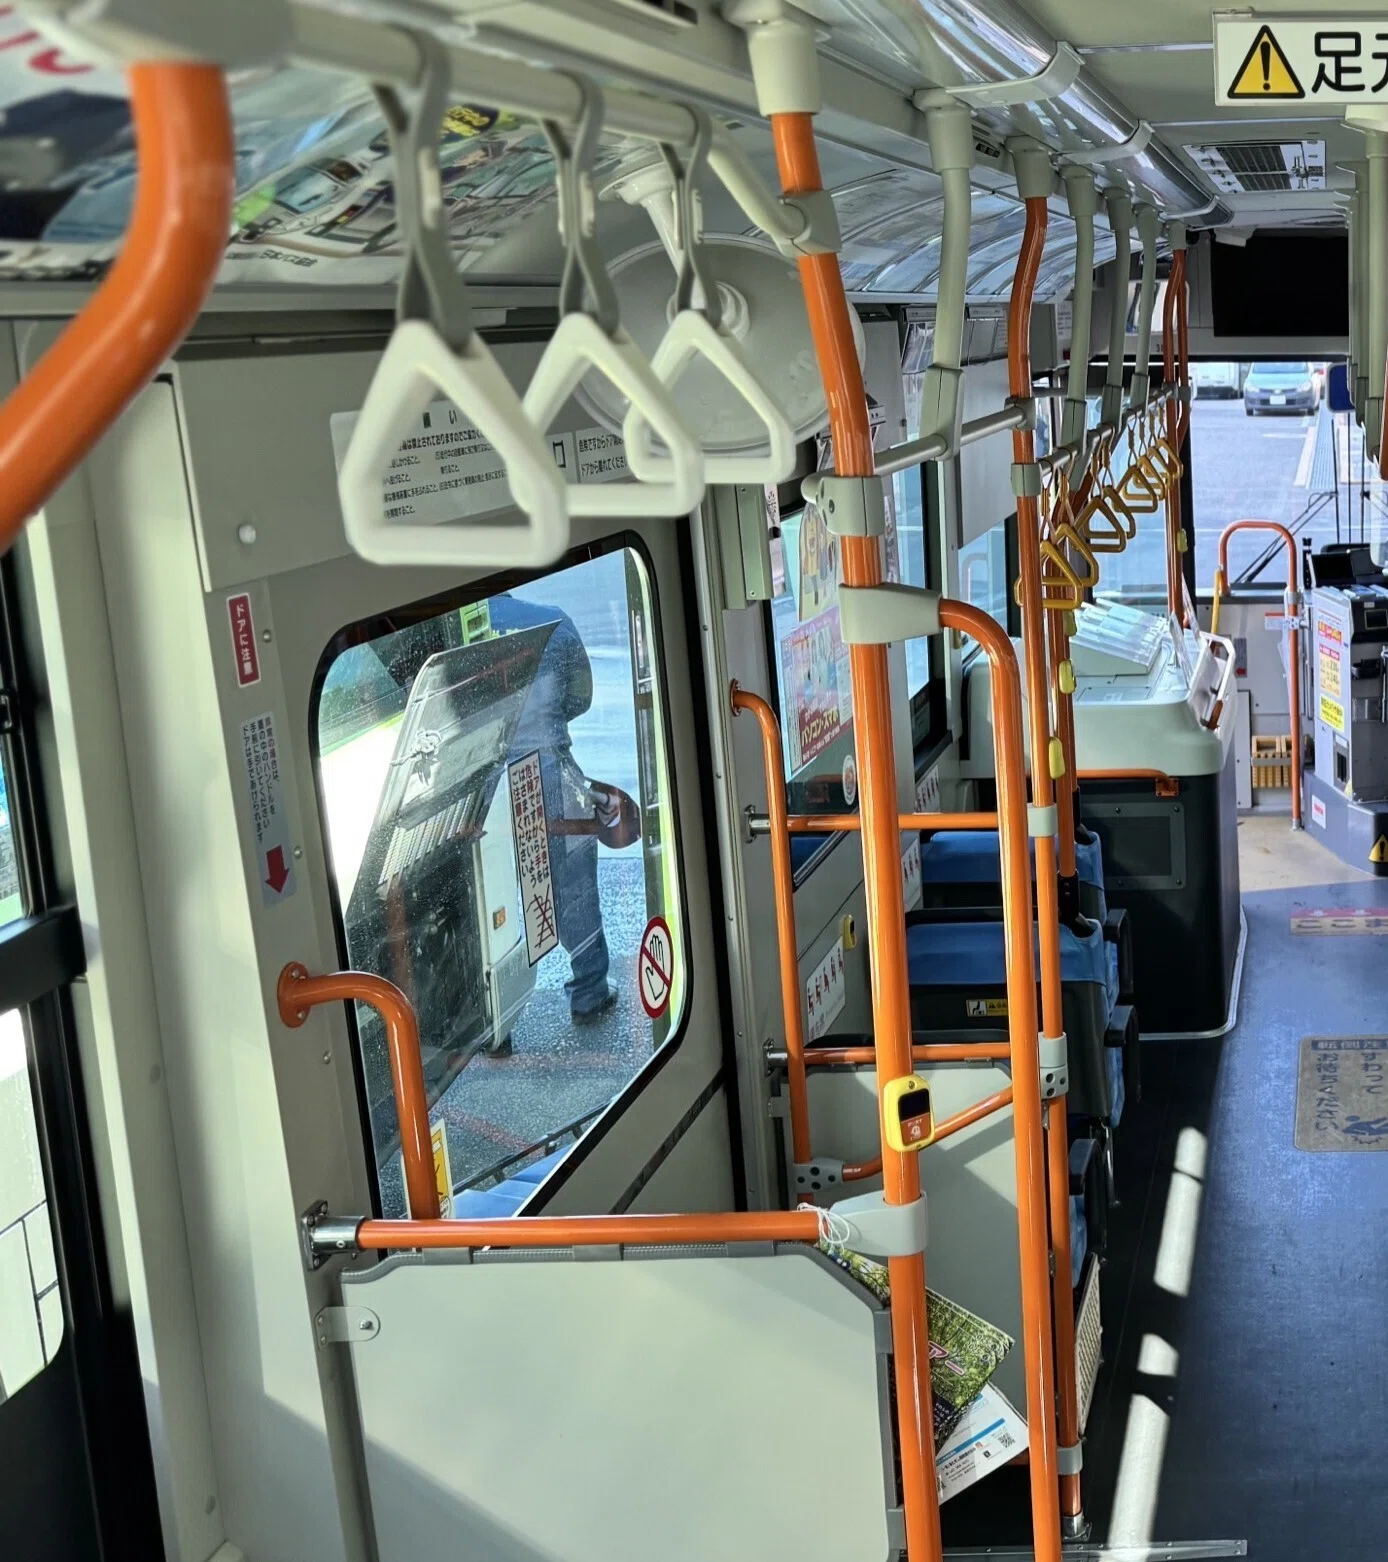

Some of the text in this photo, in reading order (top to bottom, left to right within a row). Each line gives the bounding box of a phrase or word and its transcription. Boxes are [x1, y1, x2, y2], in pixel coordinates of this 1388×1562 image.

[518, 769, 537, 889] はさまれないよう
[525, 764, 544, 883] 危険ですから手を
[531, 759, 550, 879] ドアが開くときは
[1315, 1052, 1340, 1132] お待ちください
[1361, 1052, 1384, 1095] すわって
